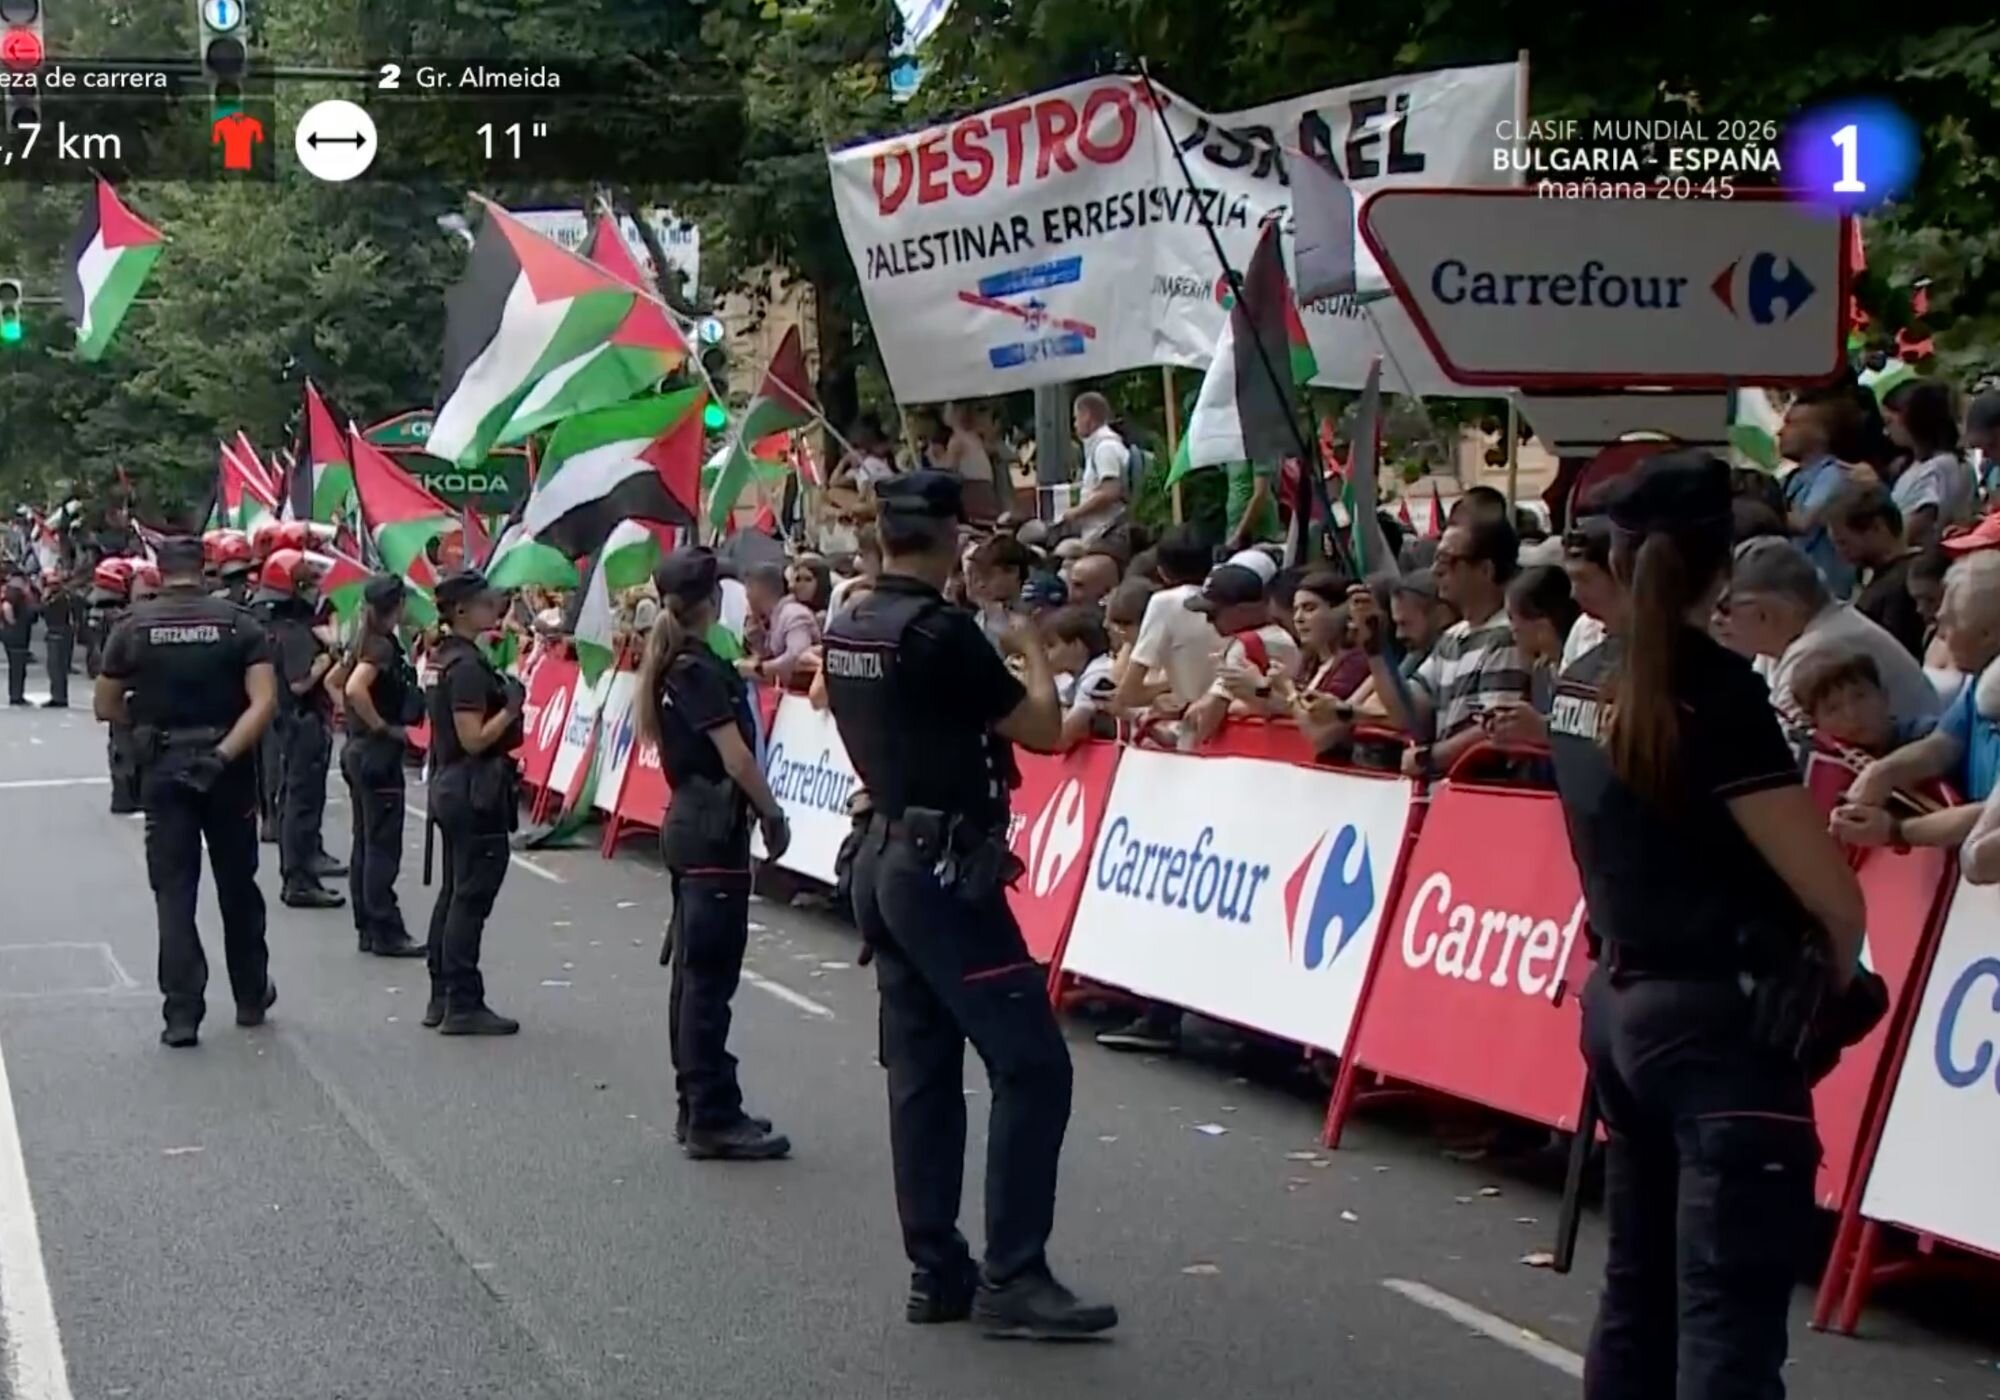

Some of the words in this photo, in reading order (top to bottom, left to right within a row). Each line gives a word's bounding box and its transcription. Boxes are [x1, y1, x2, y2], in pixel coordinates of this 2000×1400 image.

[1431, 259, 1688, 308] Carrefour
[826, 648, 884, 678] ERTZAINTZA
[767, 742, 855, 816] Carrefour
[1097, 815, 1270, 924] Carrefour
